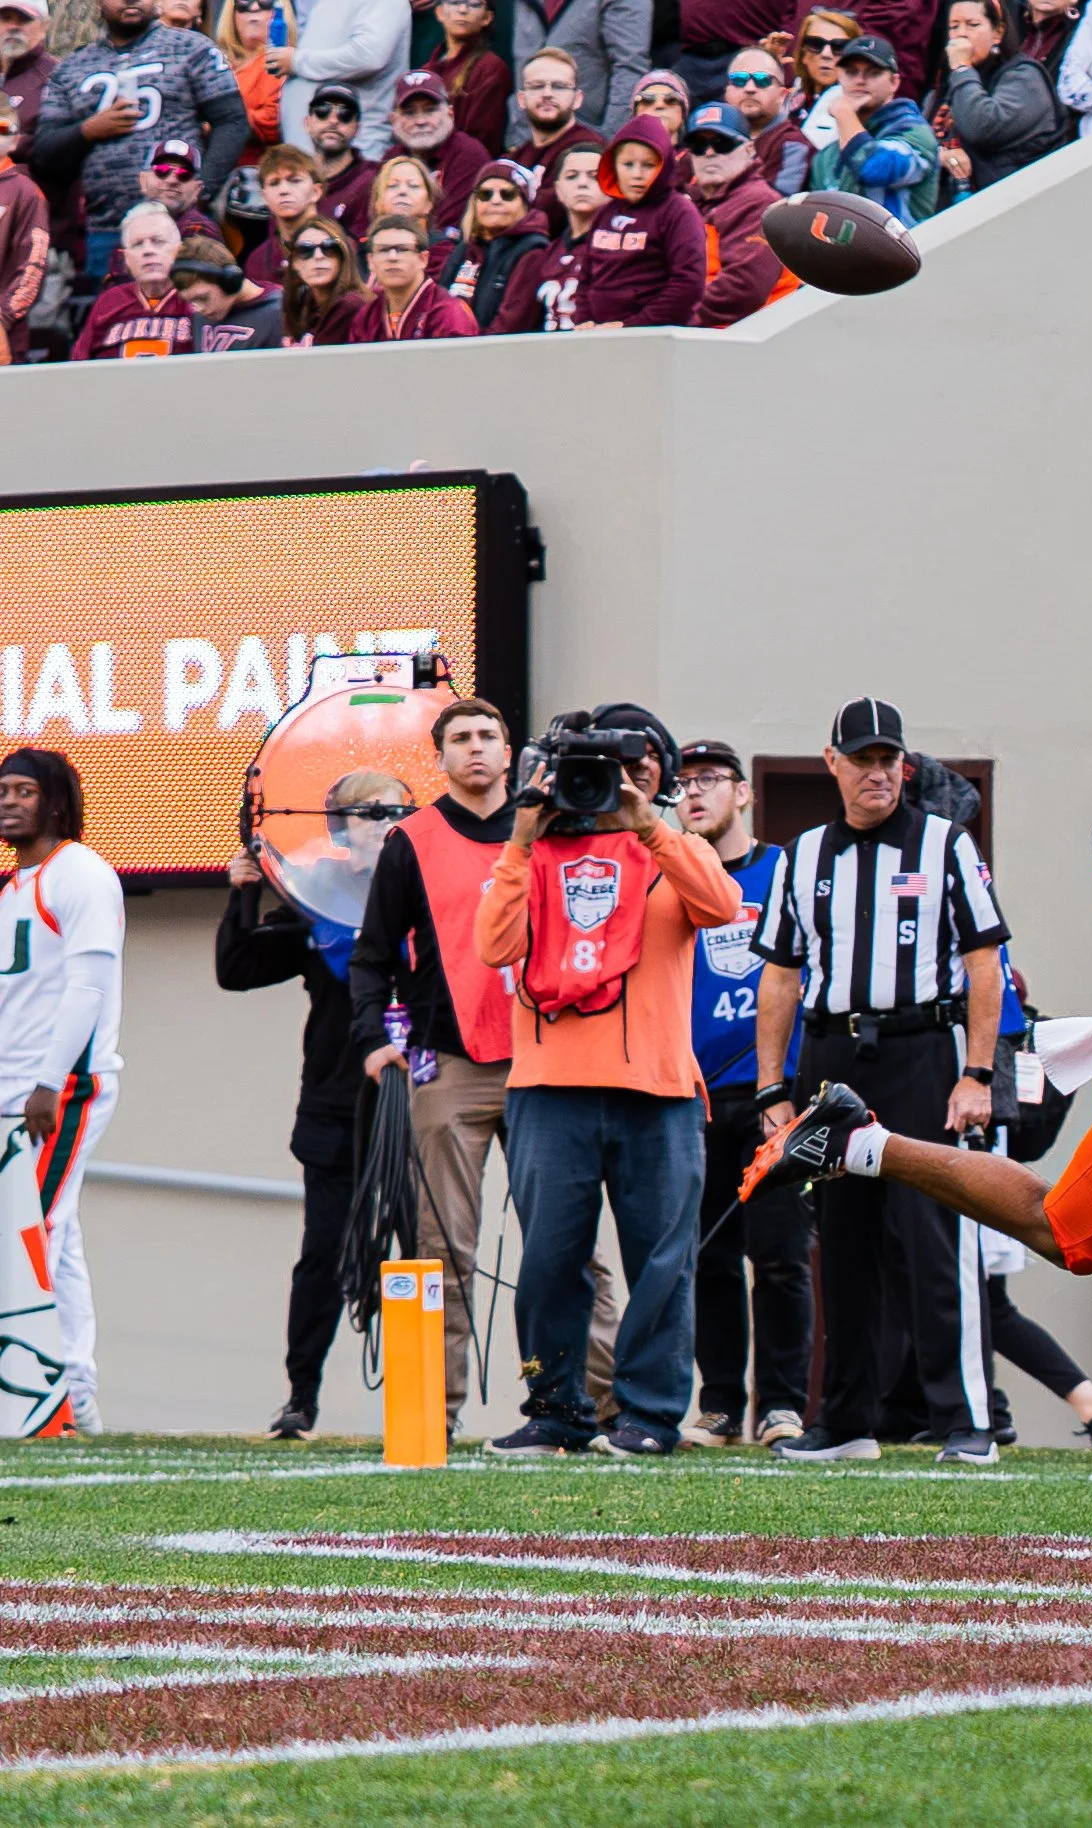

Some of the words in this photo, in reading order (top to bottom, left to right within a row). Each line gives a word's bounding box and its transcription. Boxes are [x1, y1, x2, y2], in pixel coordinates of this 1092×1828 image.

[163, 629, 439, 732] PAI
[816, 879, 832, 897] S
[707, 927, 755, 946] COLLEG
[899, 920, 917, 945] S
[713, 986, 758, 1021] 42
